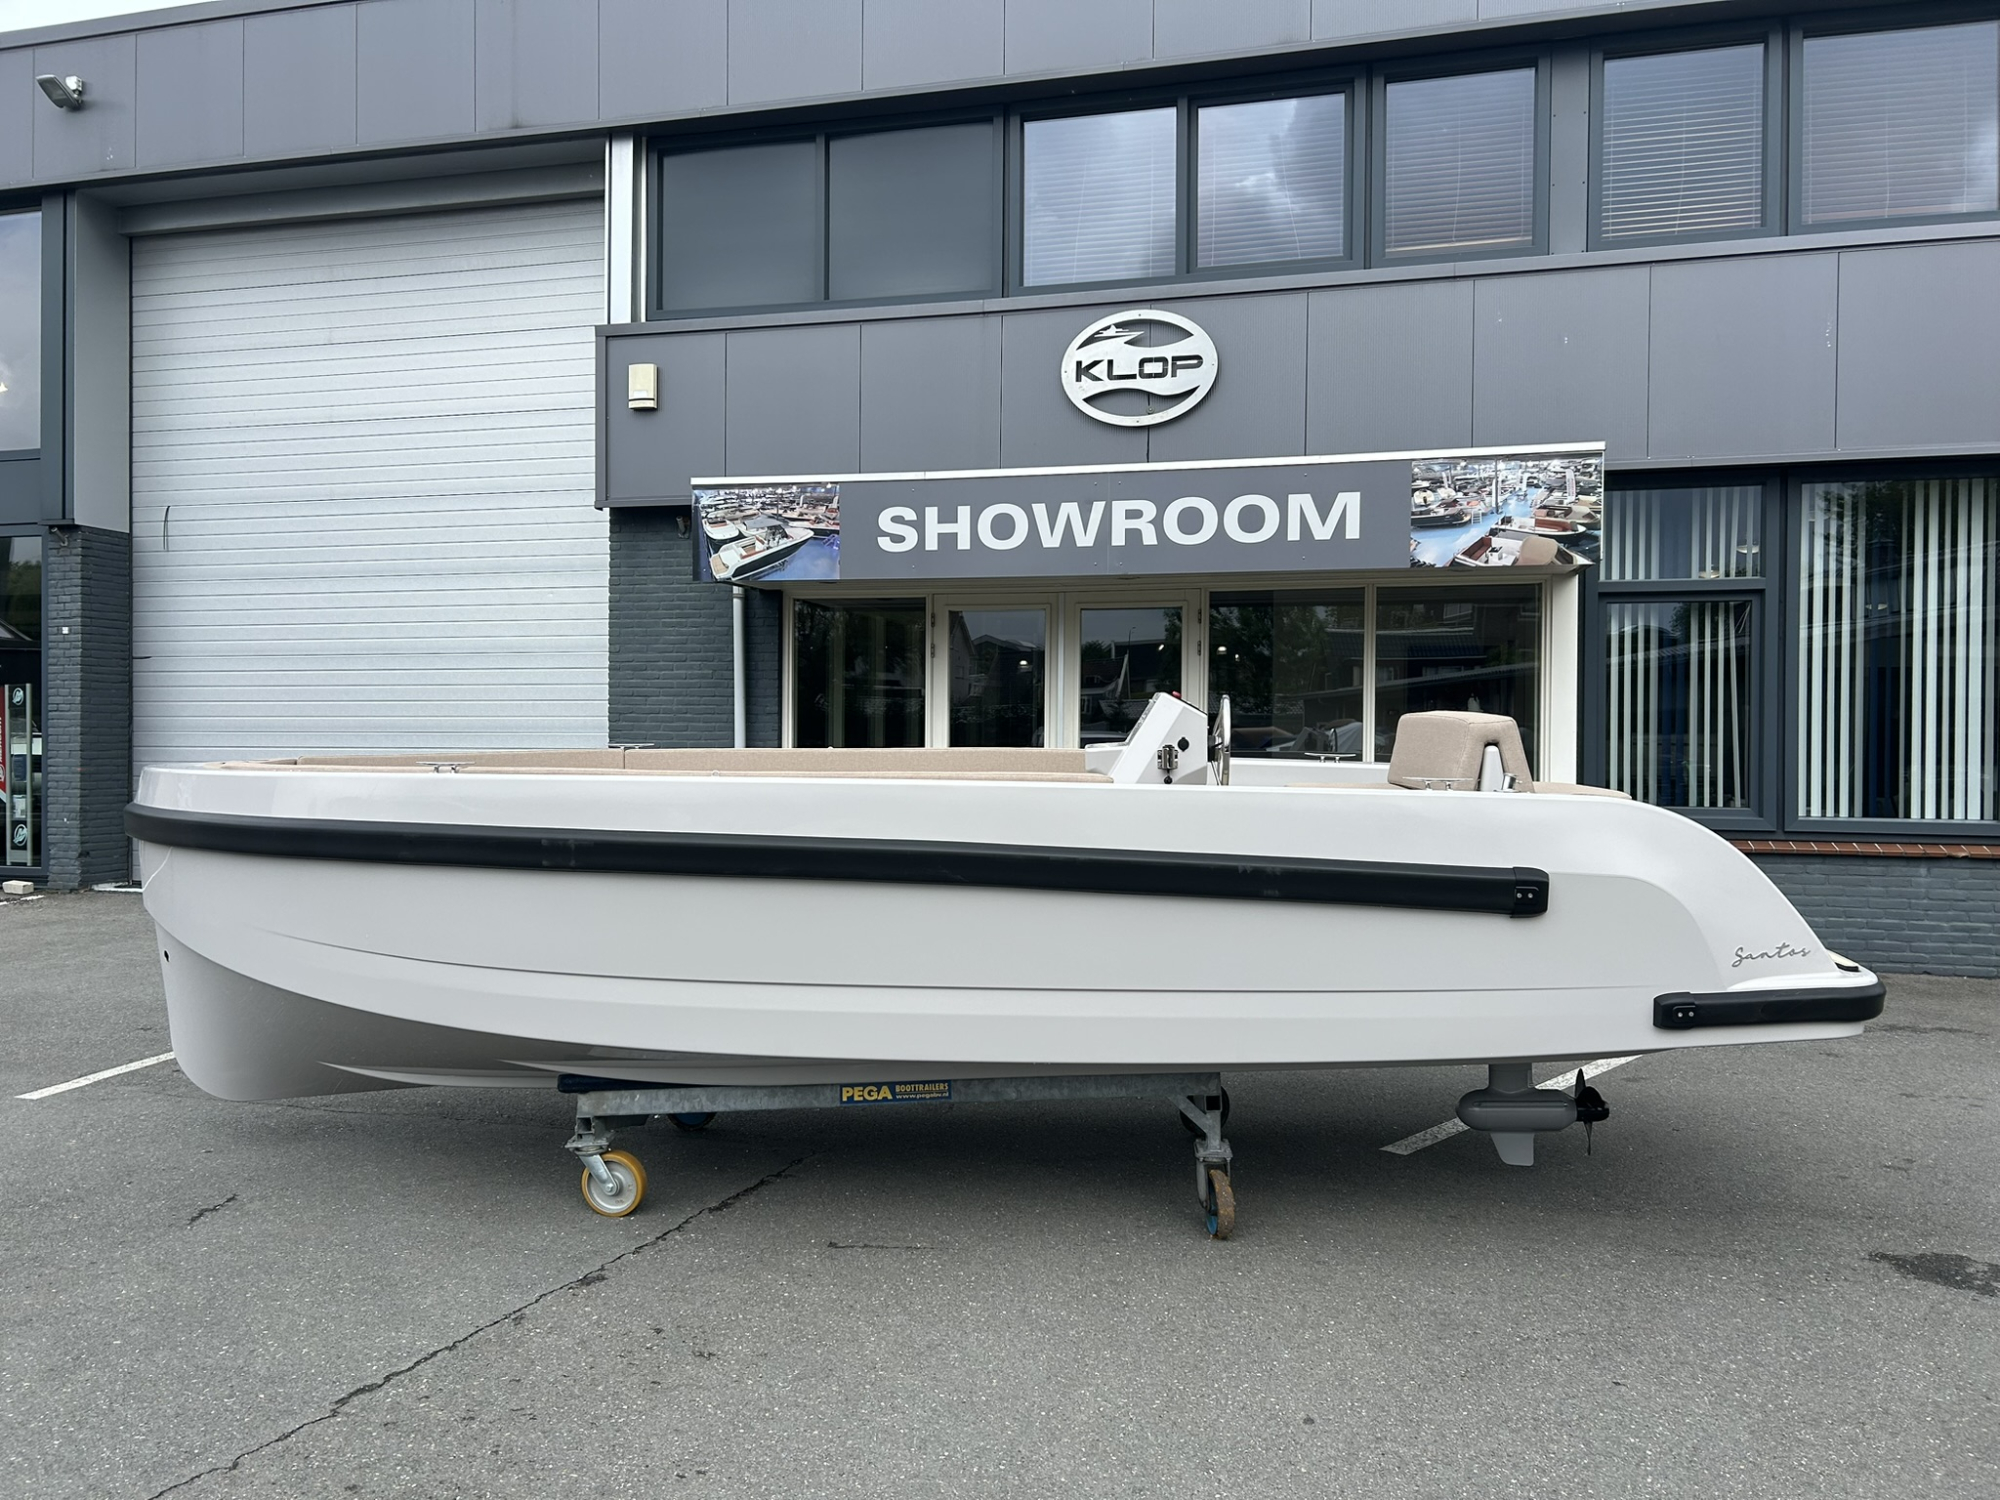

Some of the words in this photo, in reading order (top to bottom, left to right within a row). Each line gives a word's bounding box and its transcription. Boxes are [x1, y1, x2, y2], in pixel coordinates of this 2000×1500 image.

[1075, 354, 1204, 383] KLOP
[876, 491, 1361, 553] SHOWROOM
[1731, 942, 1811, 967] Santos
[842, 1085, 893, 1102] PEGA
[895, 1082, 949, 1093] BOOTTRAILERS
